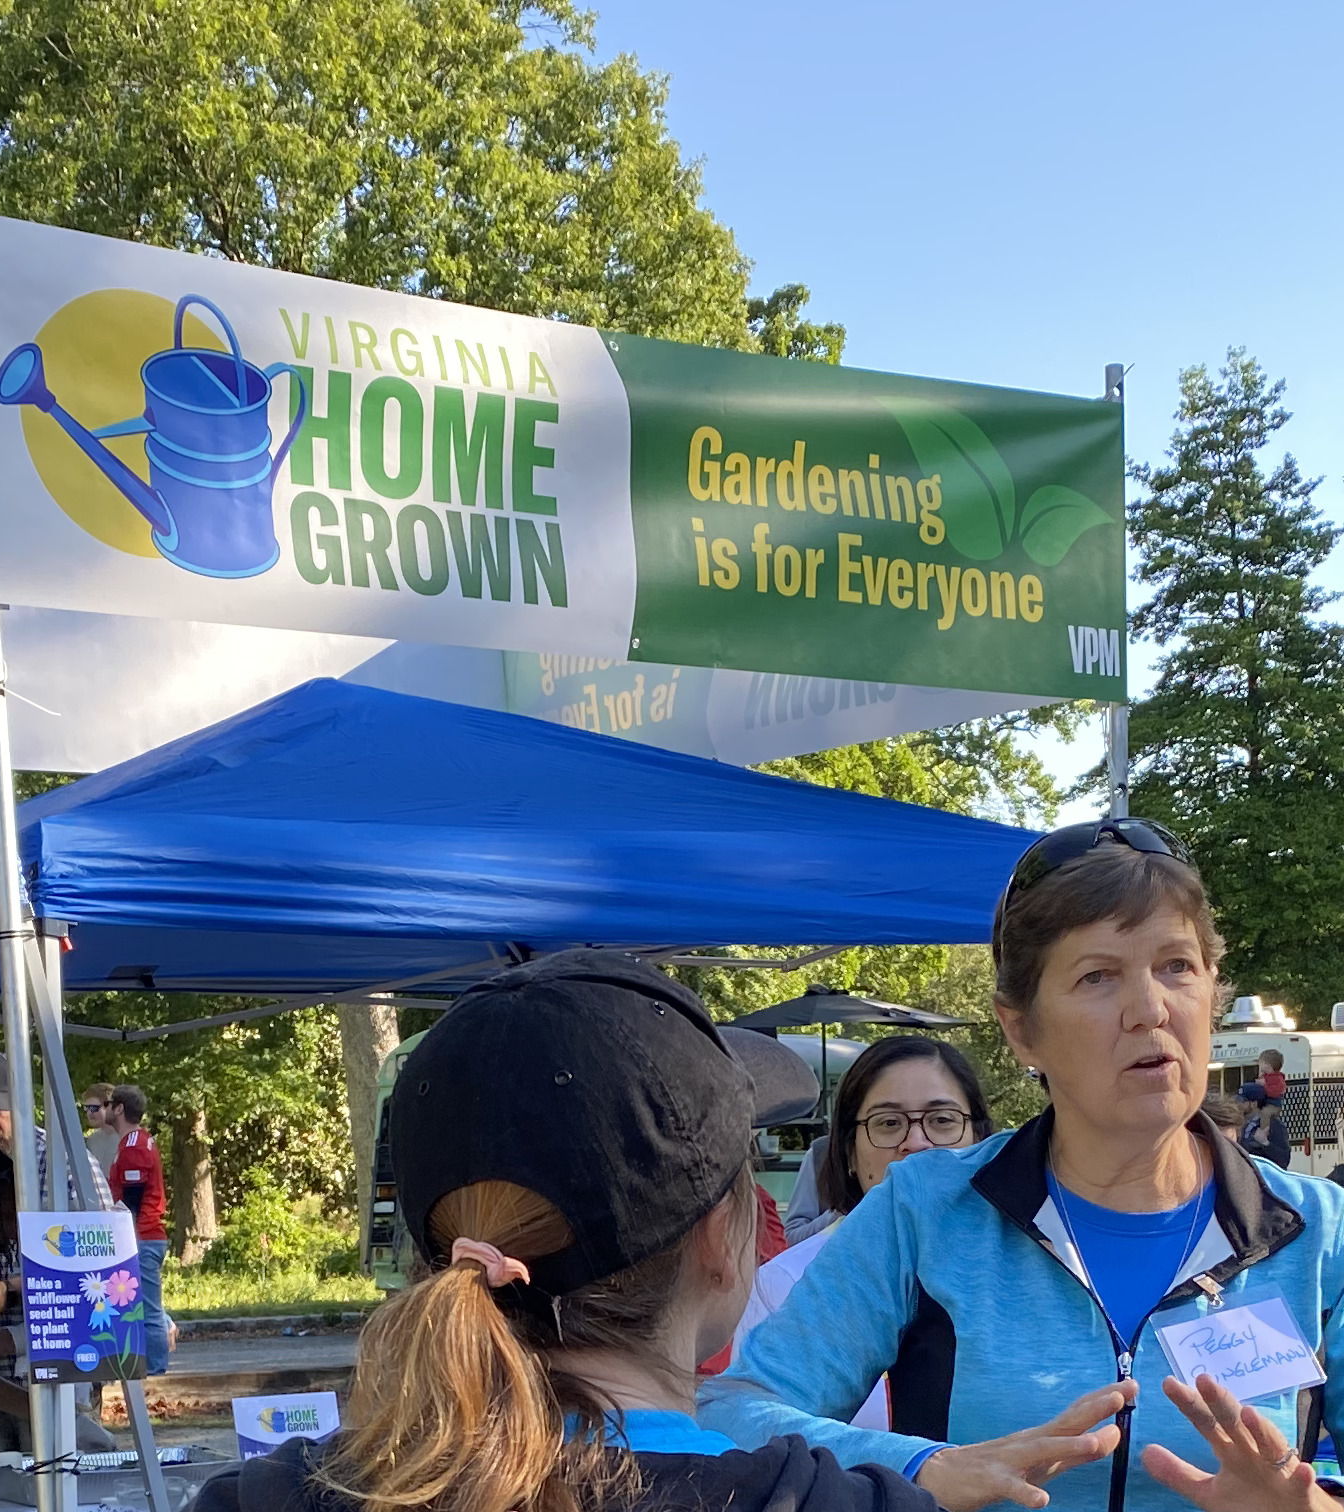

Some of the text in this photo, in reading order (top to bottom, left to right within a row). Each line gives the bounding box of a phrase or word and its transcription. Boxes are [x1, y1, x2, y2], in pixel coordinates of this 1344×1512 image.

[279, 308, 558, 397] VIRGINIA
[289, 364, 559, 517] HOME
[687, 426, 946, 545] Gardening
[290, 491, 568, 608] GROWN
[691, 517, 1044, 631] is for Everyone
[1068, 625, 1121, 677] VPM
[77, 1231, 114, 1245] HOME
[77, 1245, 116, 1257] GROWN
[27, 1277, 62, 1290] Make a
[28, 1292, 81, 1304] wildflower
[29, 1307, 75, 1320] seed ball
[30, 1322, 69, 1337] to plant
[32, 1338, 72, 1350] at home
[286, 1409, 318, 1422] HOME
[287, 1421, 319, 1432] GROWN
